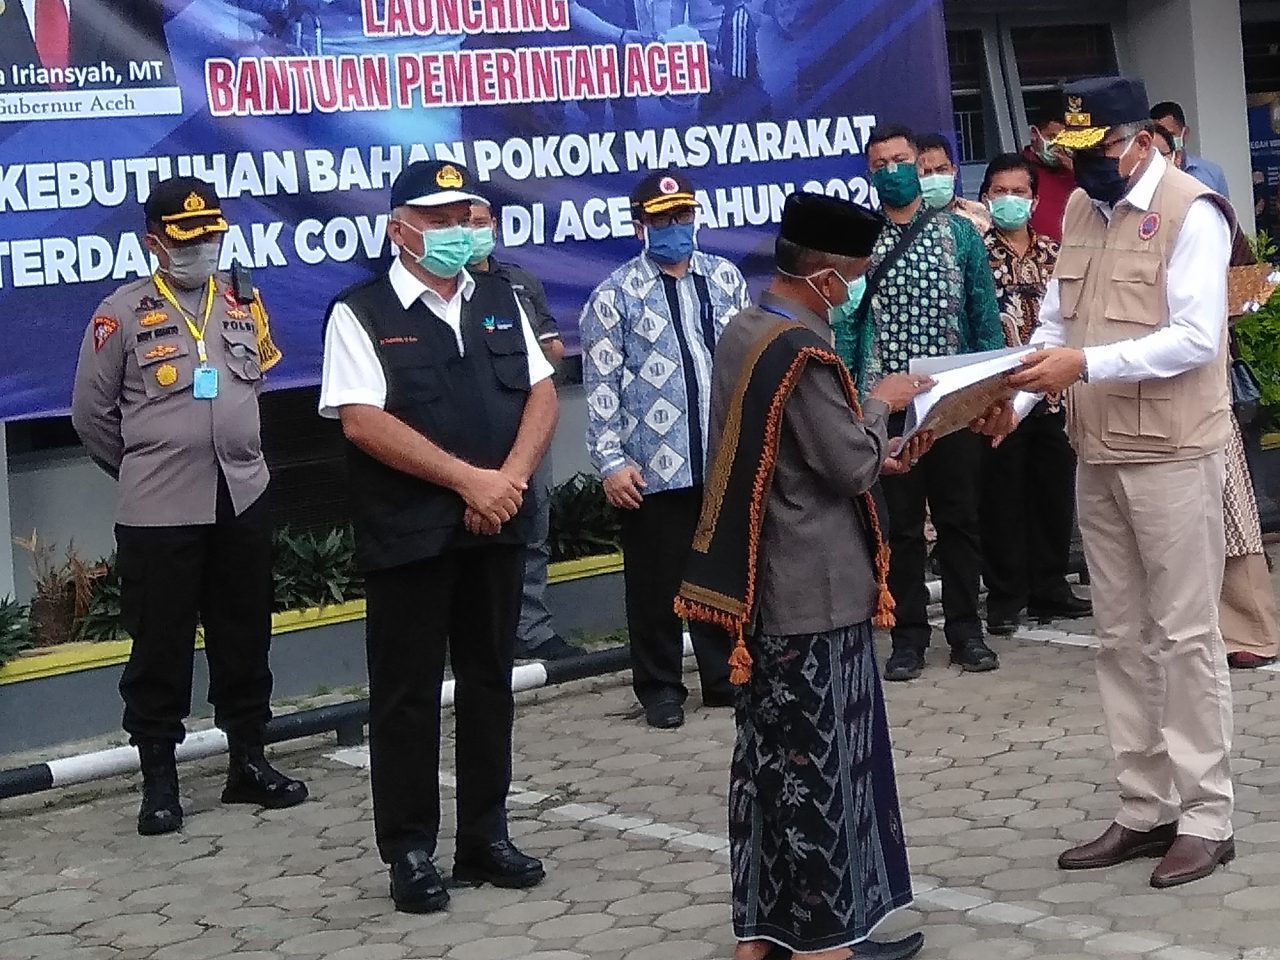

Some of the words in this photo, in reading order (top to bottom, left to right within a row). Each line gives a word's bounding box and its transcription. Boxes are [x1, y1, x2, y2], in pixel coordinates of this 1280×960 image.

[12, 61, 122, 87] Iriansyah,
[129, 61, 163, 81] MT
[90, 94, 135, 112] Aceh
[206, 55, 390, 116] BANTUAN
[396, 44, 621, 108] PEMERINTAH
[625, 41, 711, 98] ACEH
[473, 131, 619, 182] POKOK
[626, 115, 876, 173] MASYARAKAT
[0, 220, 288, 288] ERDAAK
[502, 200, 544, 247] DI
[554, 196, 636, 244] ACE
[694, 182, 795, 233] AHUN
